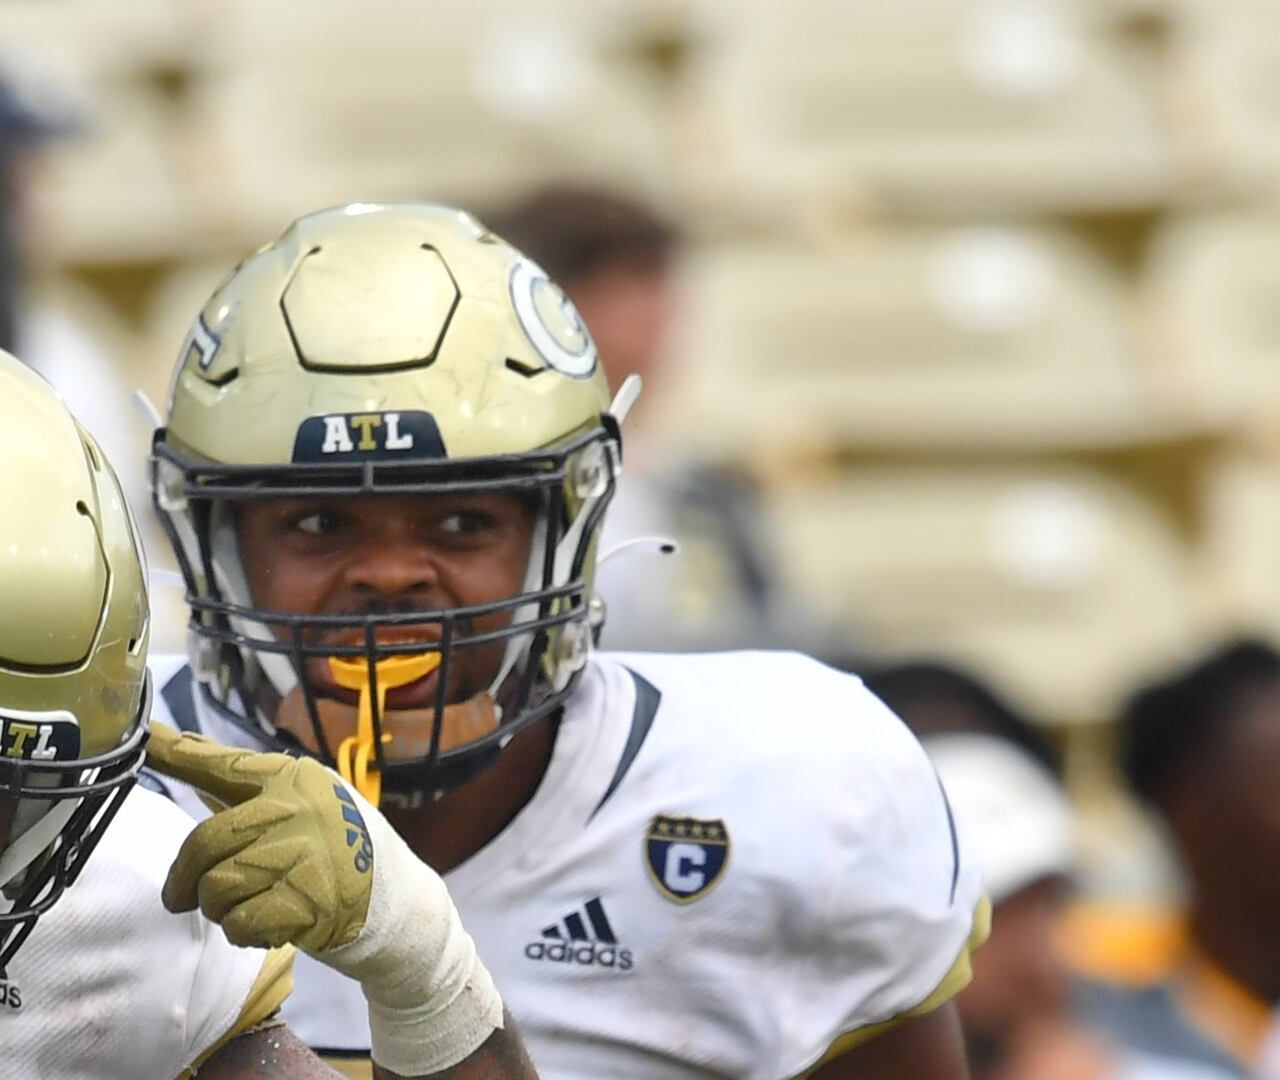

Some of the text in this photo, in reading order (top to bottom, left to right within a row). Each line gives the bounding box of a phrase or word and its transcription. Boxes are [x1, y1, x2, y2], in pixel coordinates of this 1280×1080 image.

[320, 413, 415, 454] ATL
[664, 842, 707, 893] C
[524, 941, 634, 971] adidas
